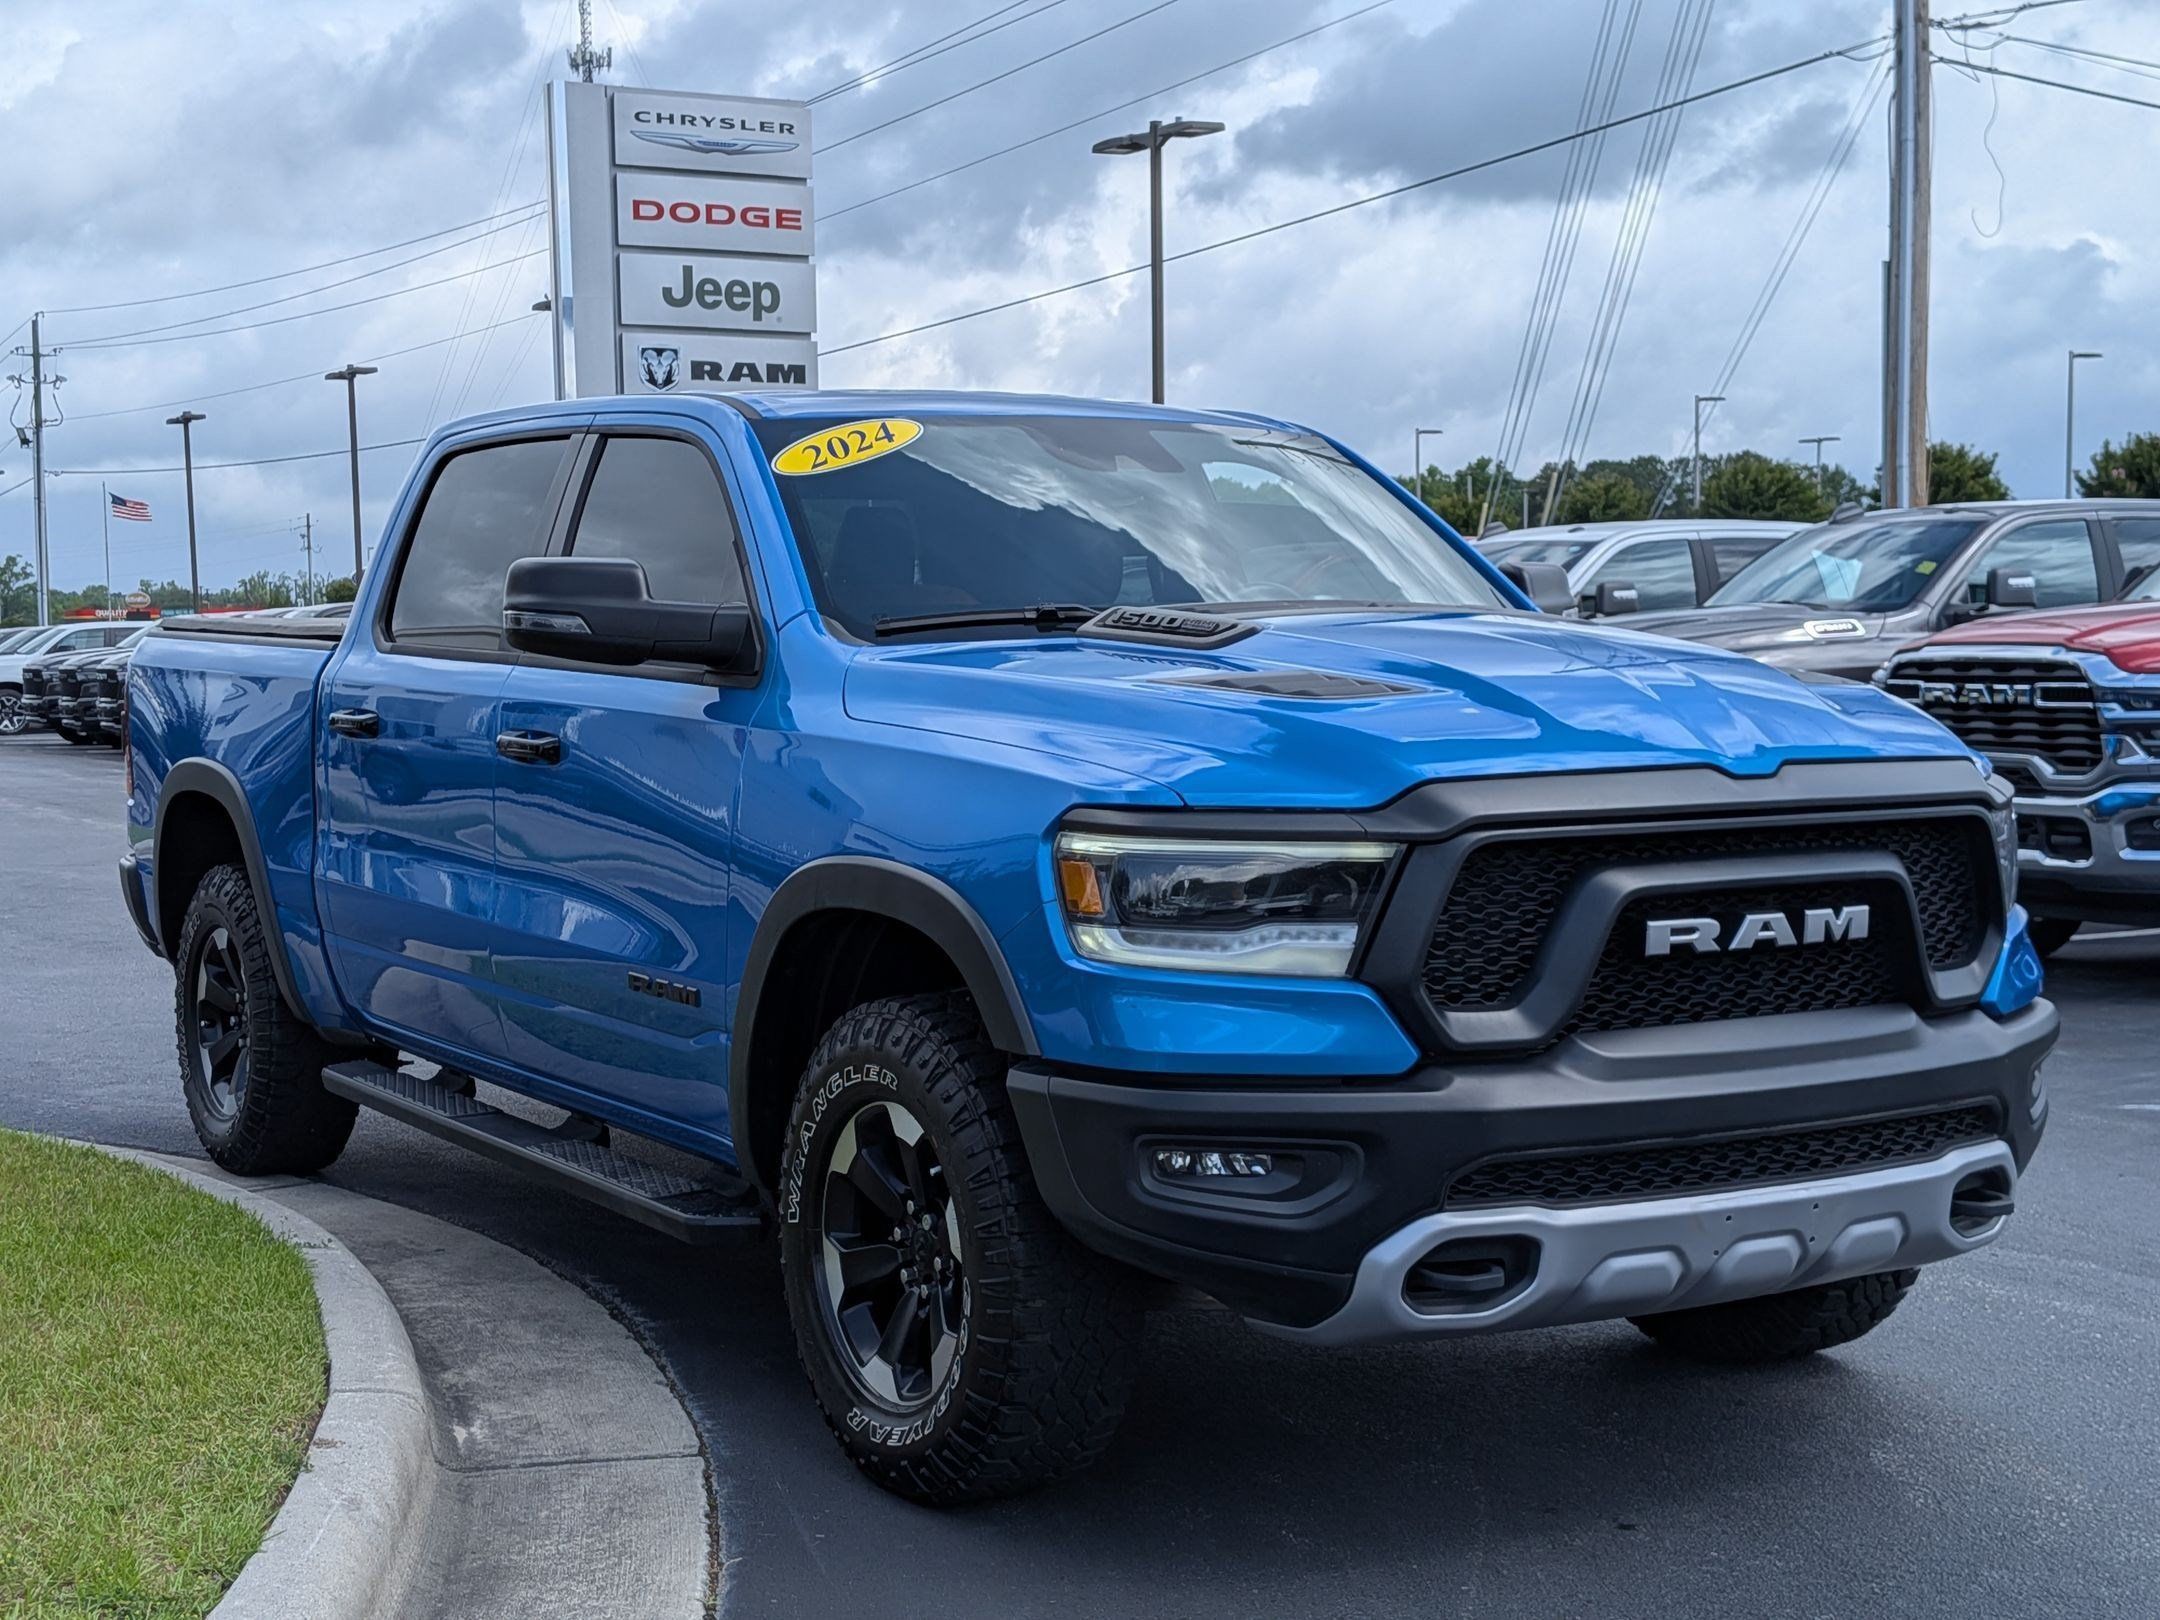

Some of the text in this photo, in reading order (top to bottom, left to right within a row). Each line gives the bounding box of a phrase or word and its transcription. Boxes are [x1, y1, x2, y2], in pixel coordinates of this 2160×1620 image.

[634, 111, 796, 135] CHRYSLER
[632, 199, 802, 231] DODGE
[662, 264, 780, 322] Jeep
[690, 359, 806, 385] RAM
[802, 421, 895, 470] 2024
[1923, 682, 2033, 704] RAM
[1645, 904, 1870, 957] RAM
[628, 971, 702, 1008] RAM
[787, 1064, 898, 1223] WRANGLER
